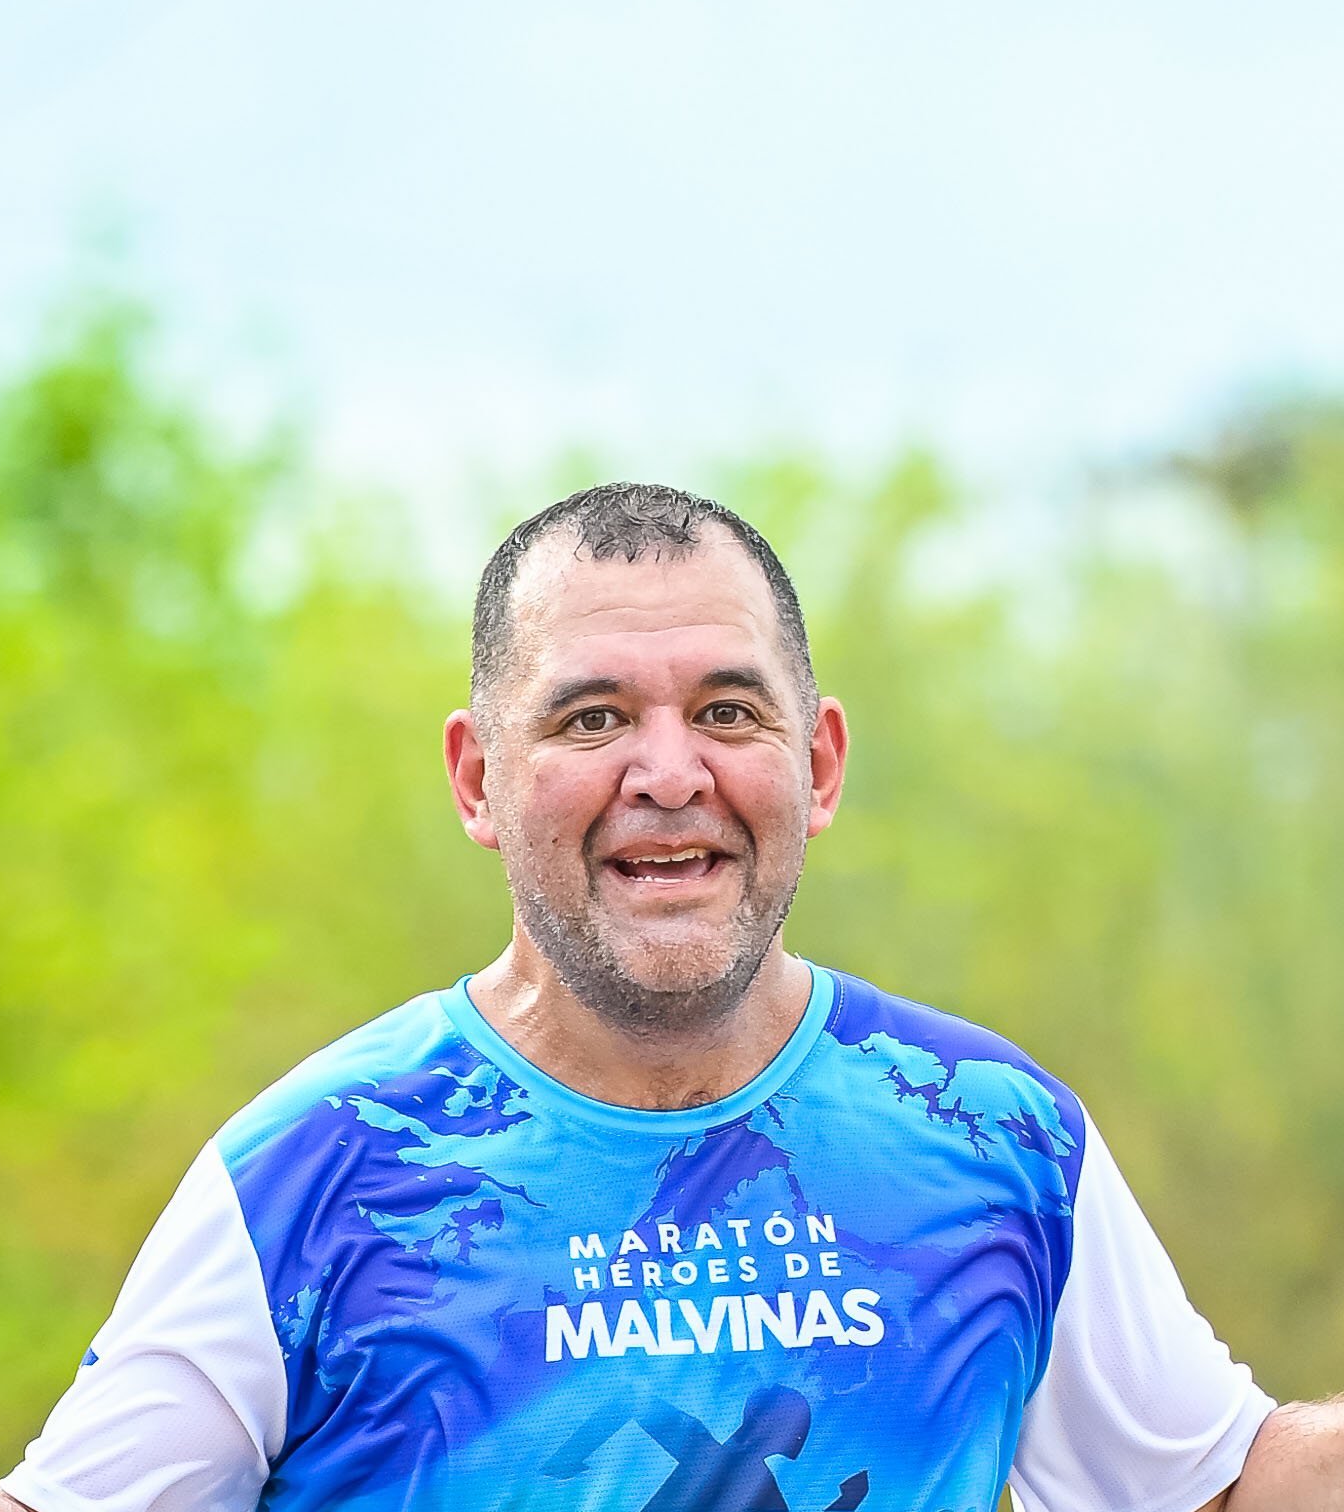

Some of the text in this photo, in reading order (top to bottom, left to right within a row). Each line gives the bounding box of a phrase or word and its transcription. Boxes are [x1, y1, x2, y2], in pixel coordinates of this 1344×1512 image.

[568, 1210, 838, 1259] MARATÓN
[573, 1251, 842, 1289] HÉROES DE
[545, 1287, 886, 1363] MALVINAS
